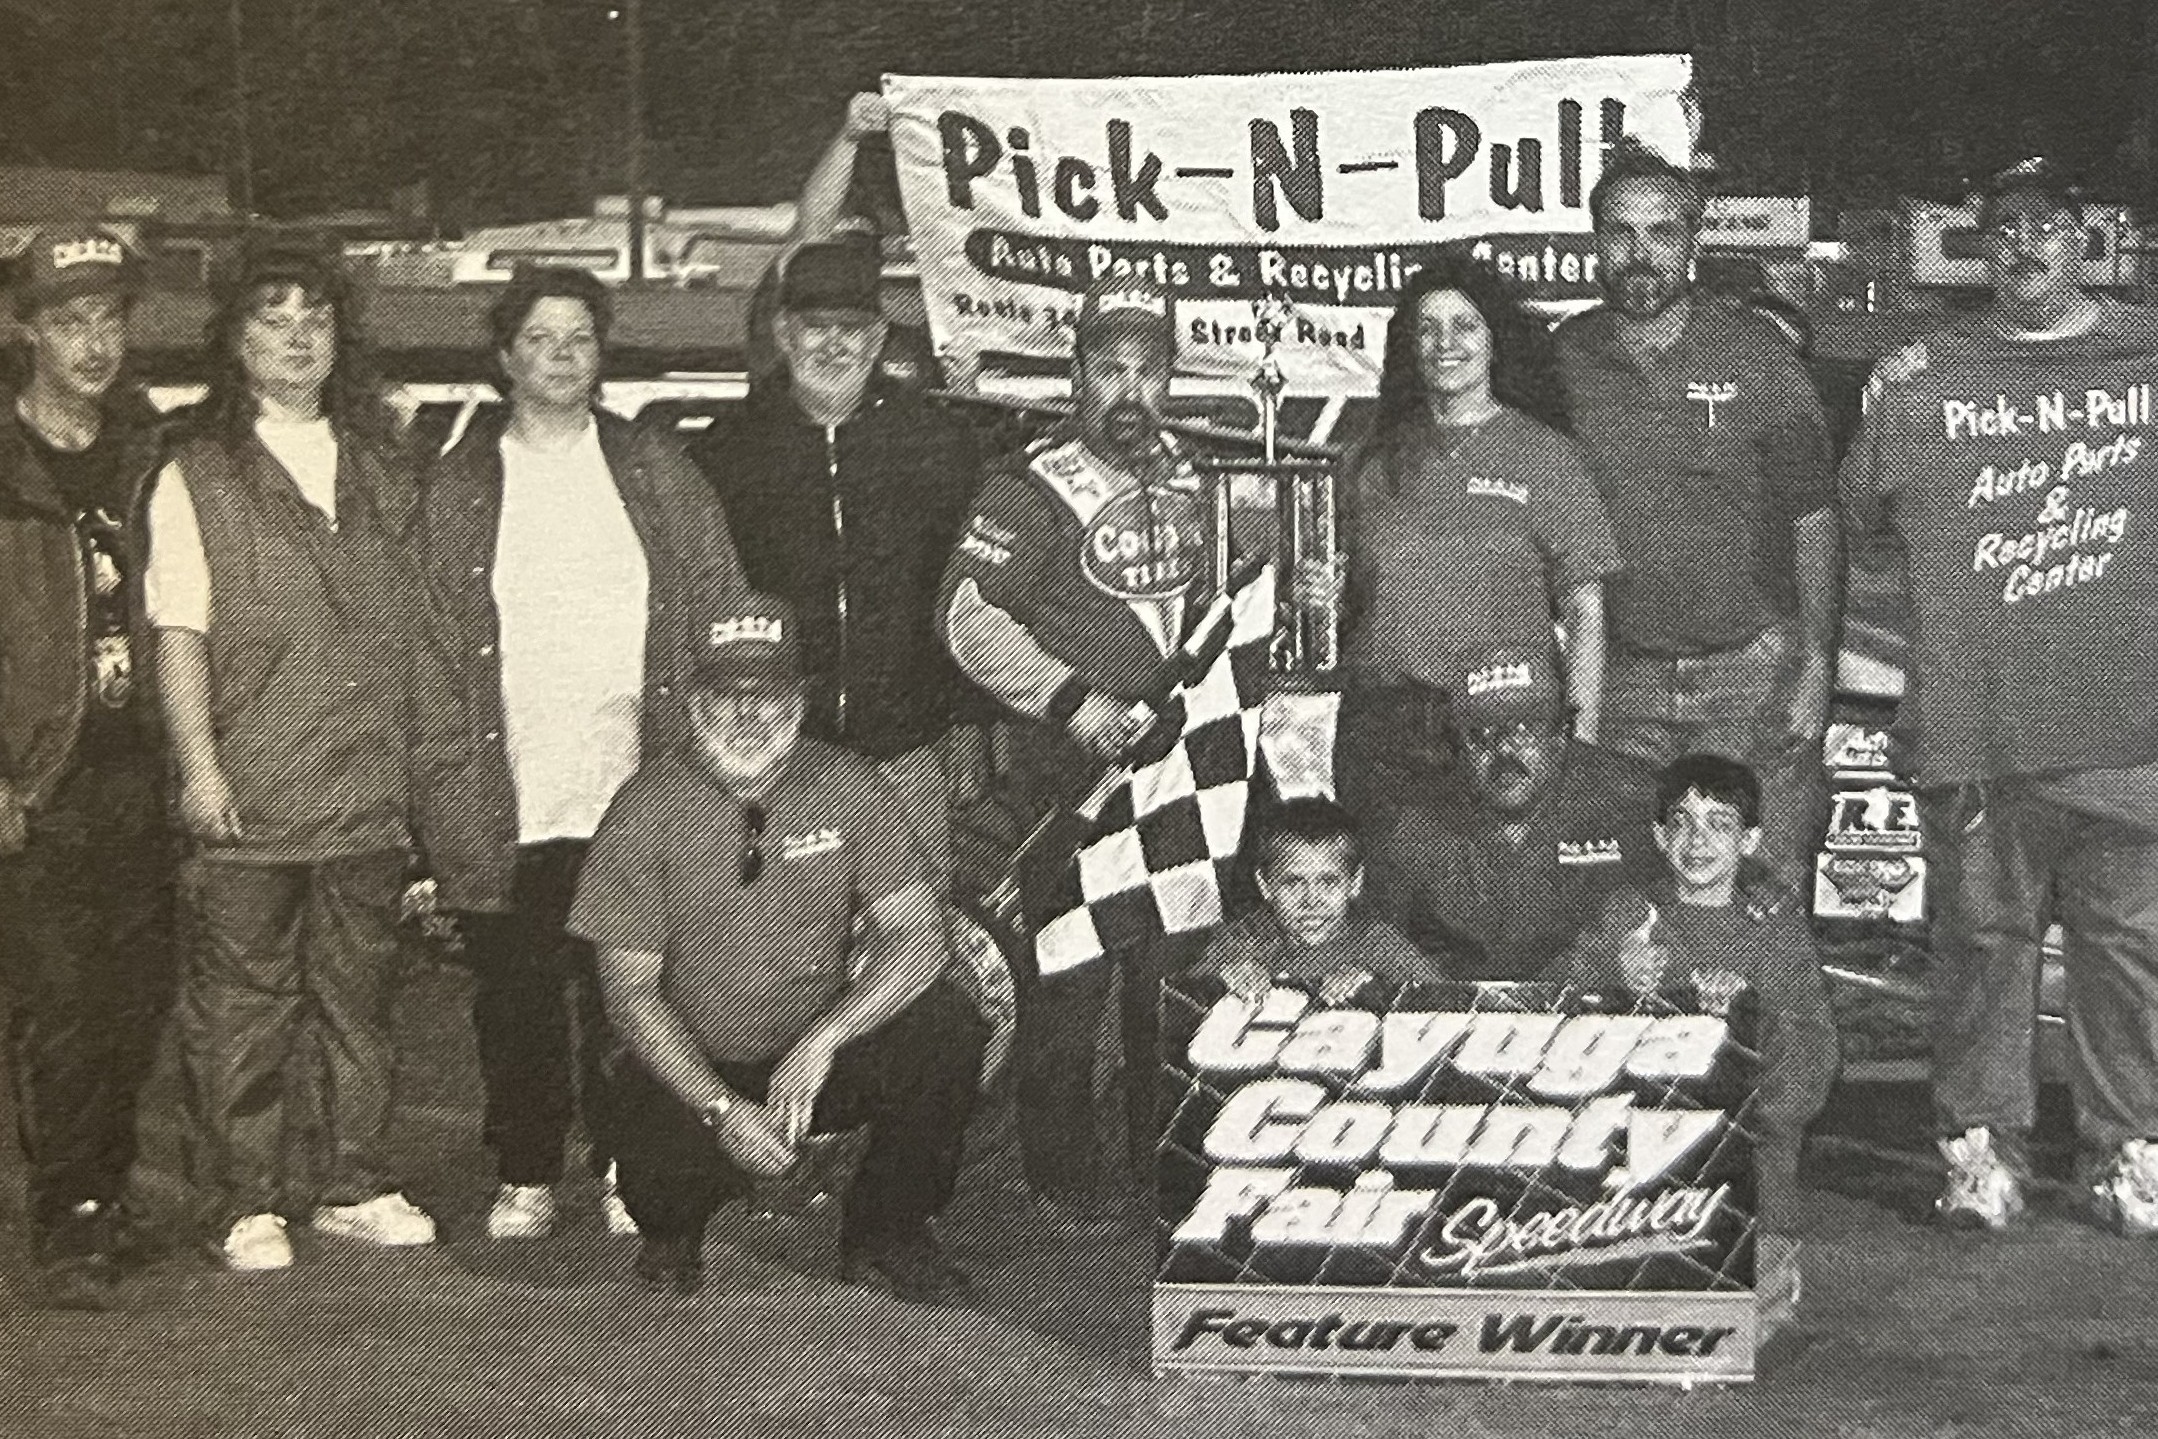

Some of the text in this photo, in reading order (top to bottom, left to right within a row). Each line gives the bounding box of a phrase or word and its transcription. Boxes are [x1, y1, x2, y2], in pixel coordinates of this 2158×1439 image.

[991, 233, 1073, 277] Auto
[1087, 244, 1190, 285] Parts
[1209, 252, 1241, 287] &
[1257, 250, 1423, 302] Recycli
[1297, 316, 1365, 351] Road
[1943, 383, 2149, 440] Pick-N-Pull
[1967, 434, 2142, 508] Auto Parts
[2037, 485, 2069, 524] &
[1973, 507, 2128, 571] Recycling
[2002, 551, 2112, 602] Center
[1187, 987, 1729, 1098] Cayuga
[1202, 1078, 1725, 1188] County
[1170, 1167, 1730, 1277] Fair Speedway
[1172, 1308, 1737, 1357] Feature Winner
